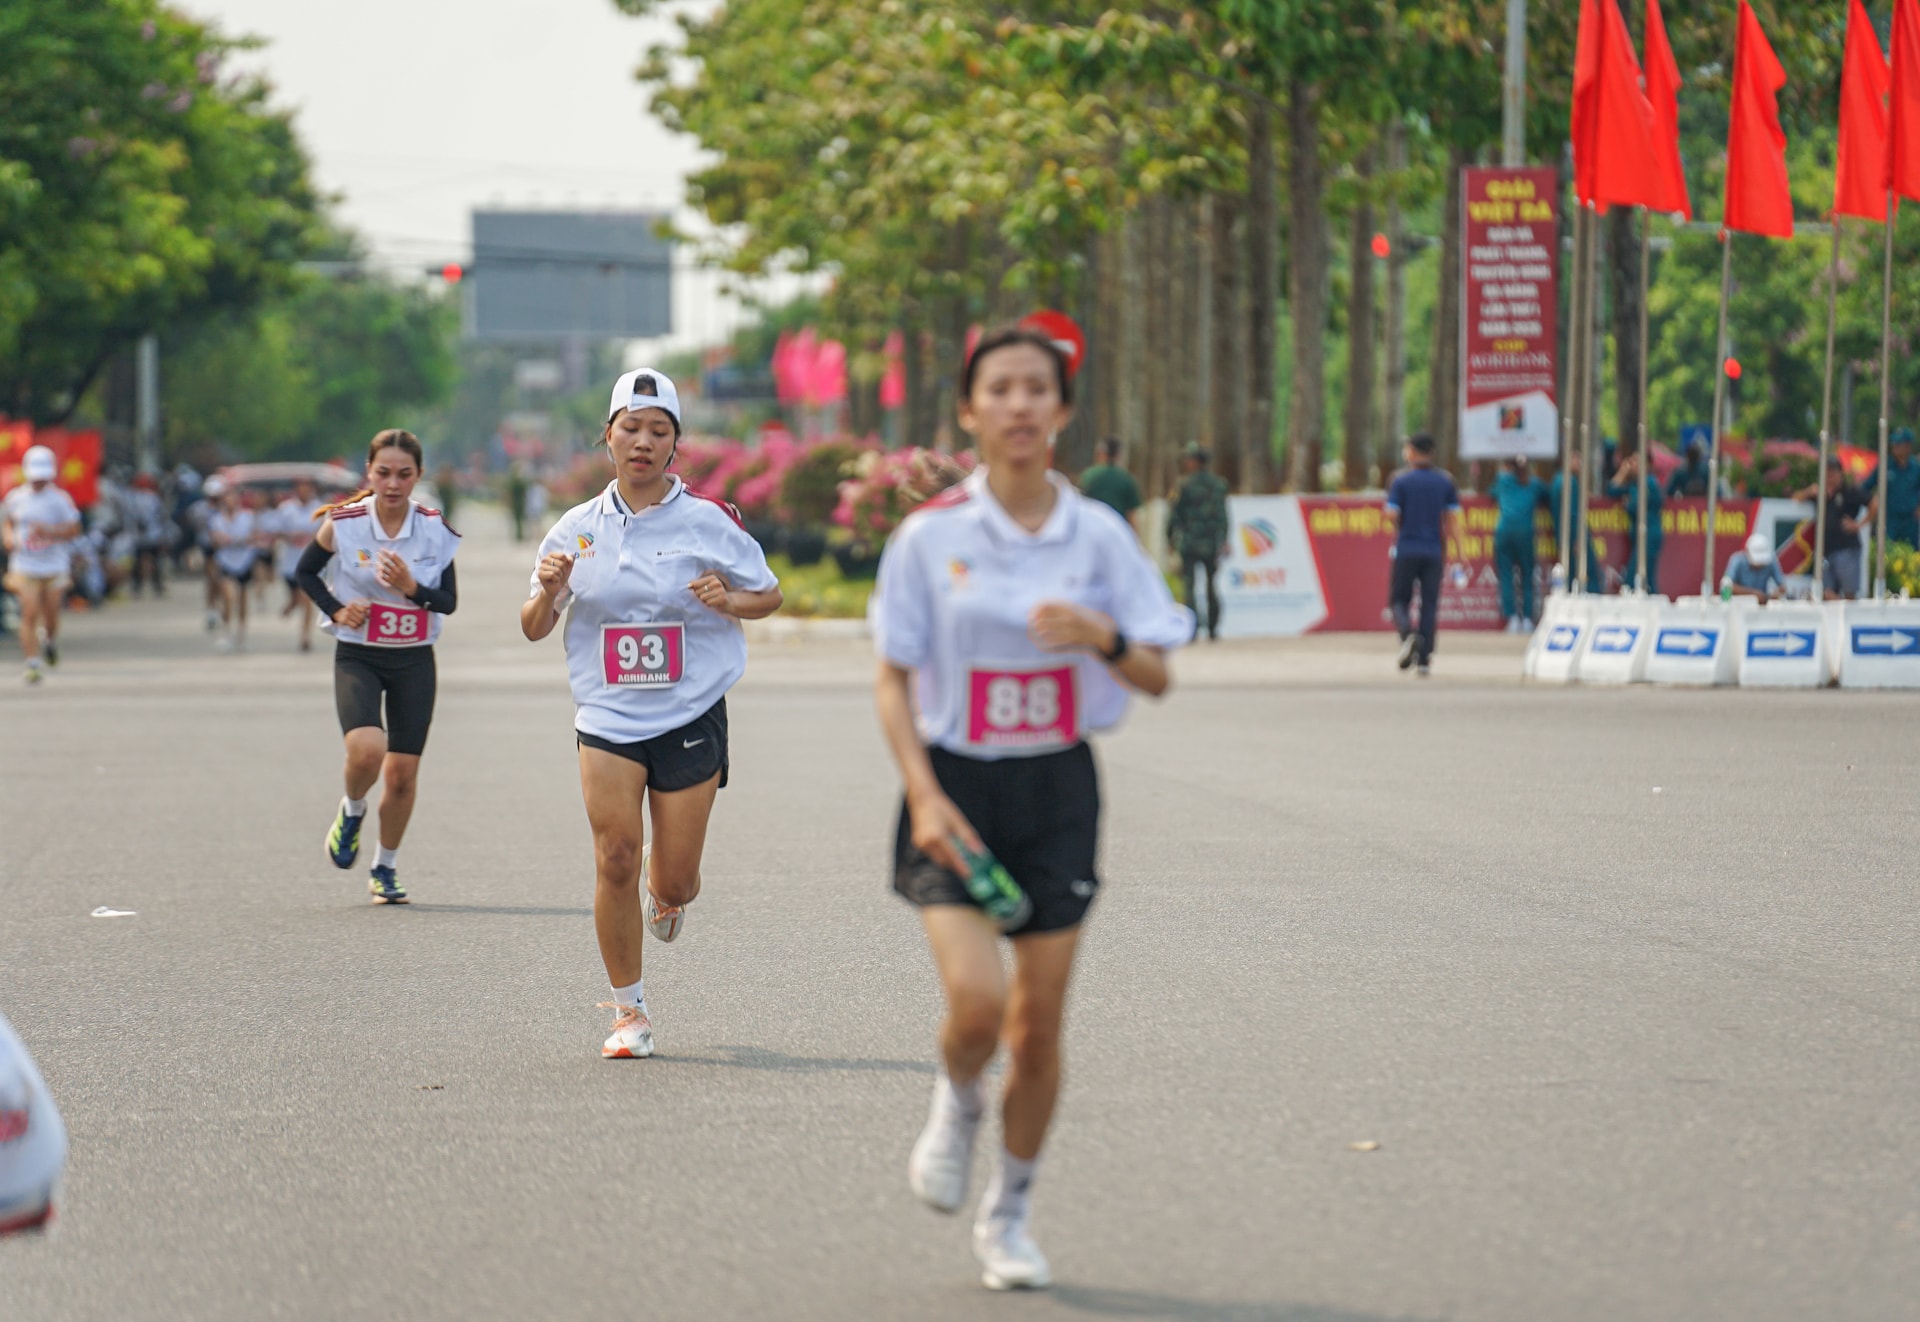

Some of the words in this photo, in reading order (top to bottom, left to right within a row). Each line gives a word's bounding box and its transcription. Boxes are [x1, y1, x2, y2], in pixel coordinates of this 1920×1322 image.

[379, 611, 418, 636] 38
[617, 634, 665, 670] 93
[617, 673, 671, 683] AGRIBANK
[985, 676, 1061, 728] 88
